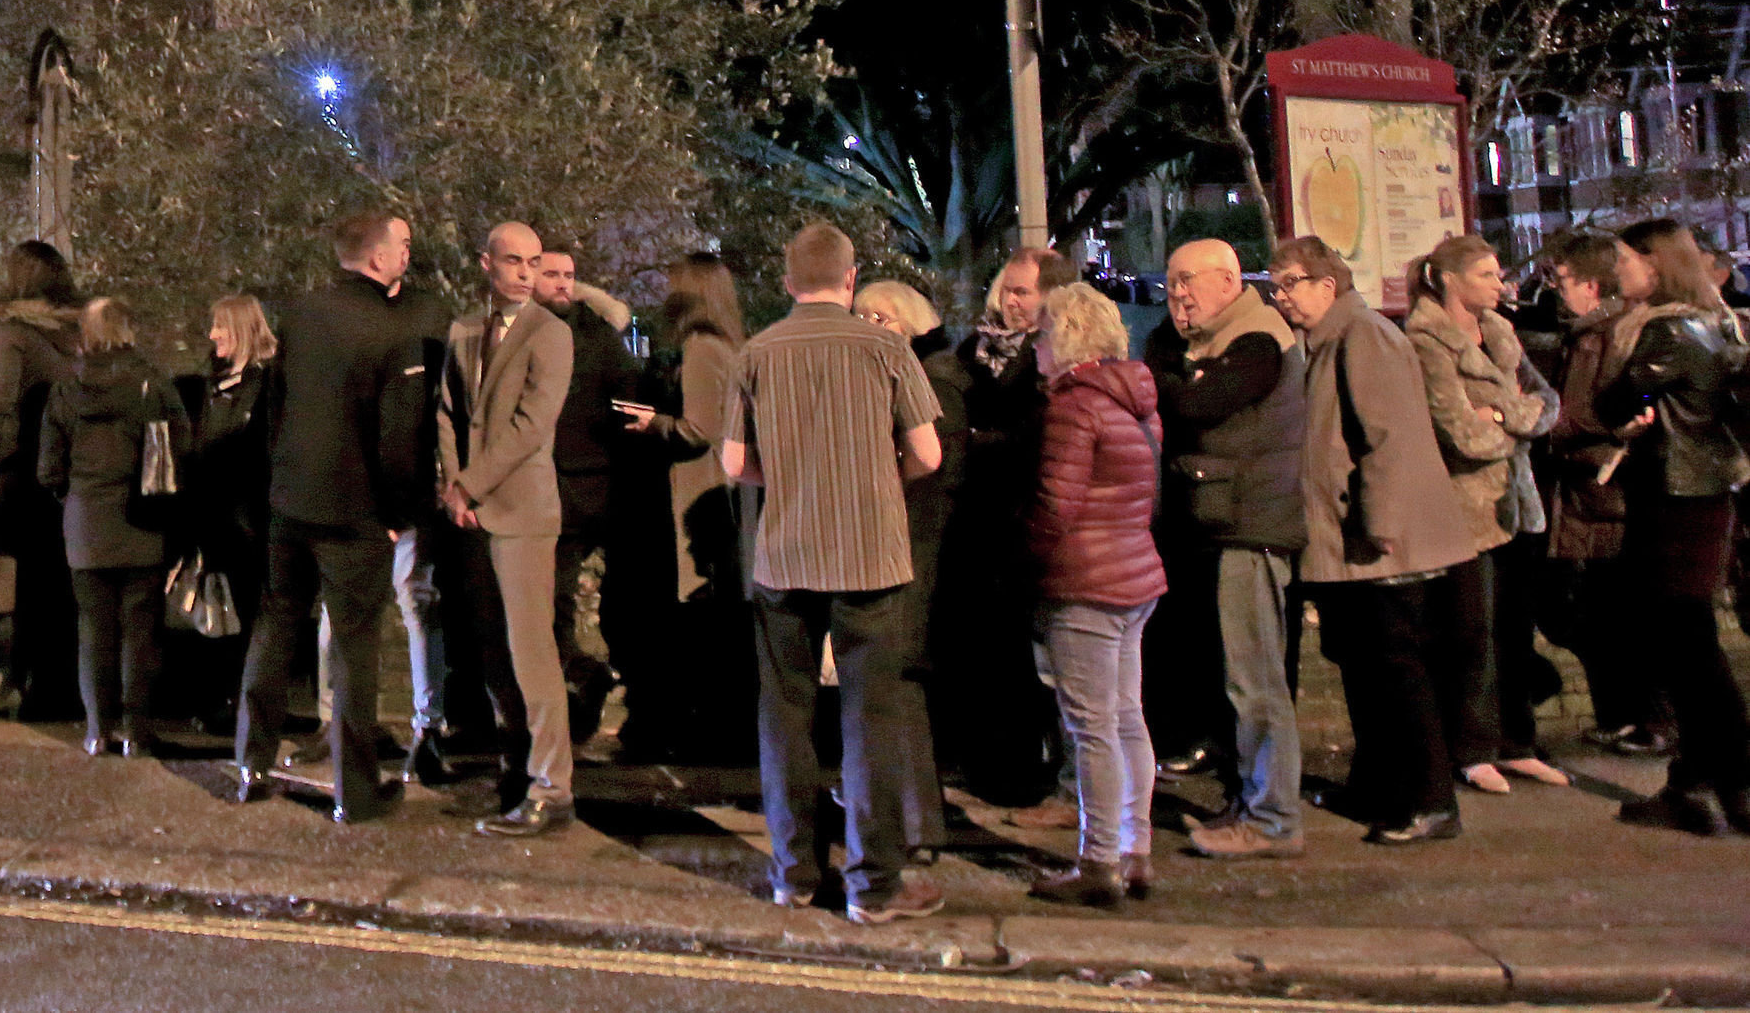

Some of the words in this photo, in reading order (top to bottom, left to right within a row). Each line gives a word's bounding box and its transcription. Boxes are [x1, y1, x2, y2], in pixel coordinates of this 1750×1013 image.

[1291, 58, 1307, 76] ST
[1309, 60, 1380, 78] MATTHEW'S
[1381, 63, 1431, 82] CHURCH
